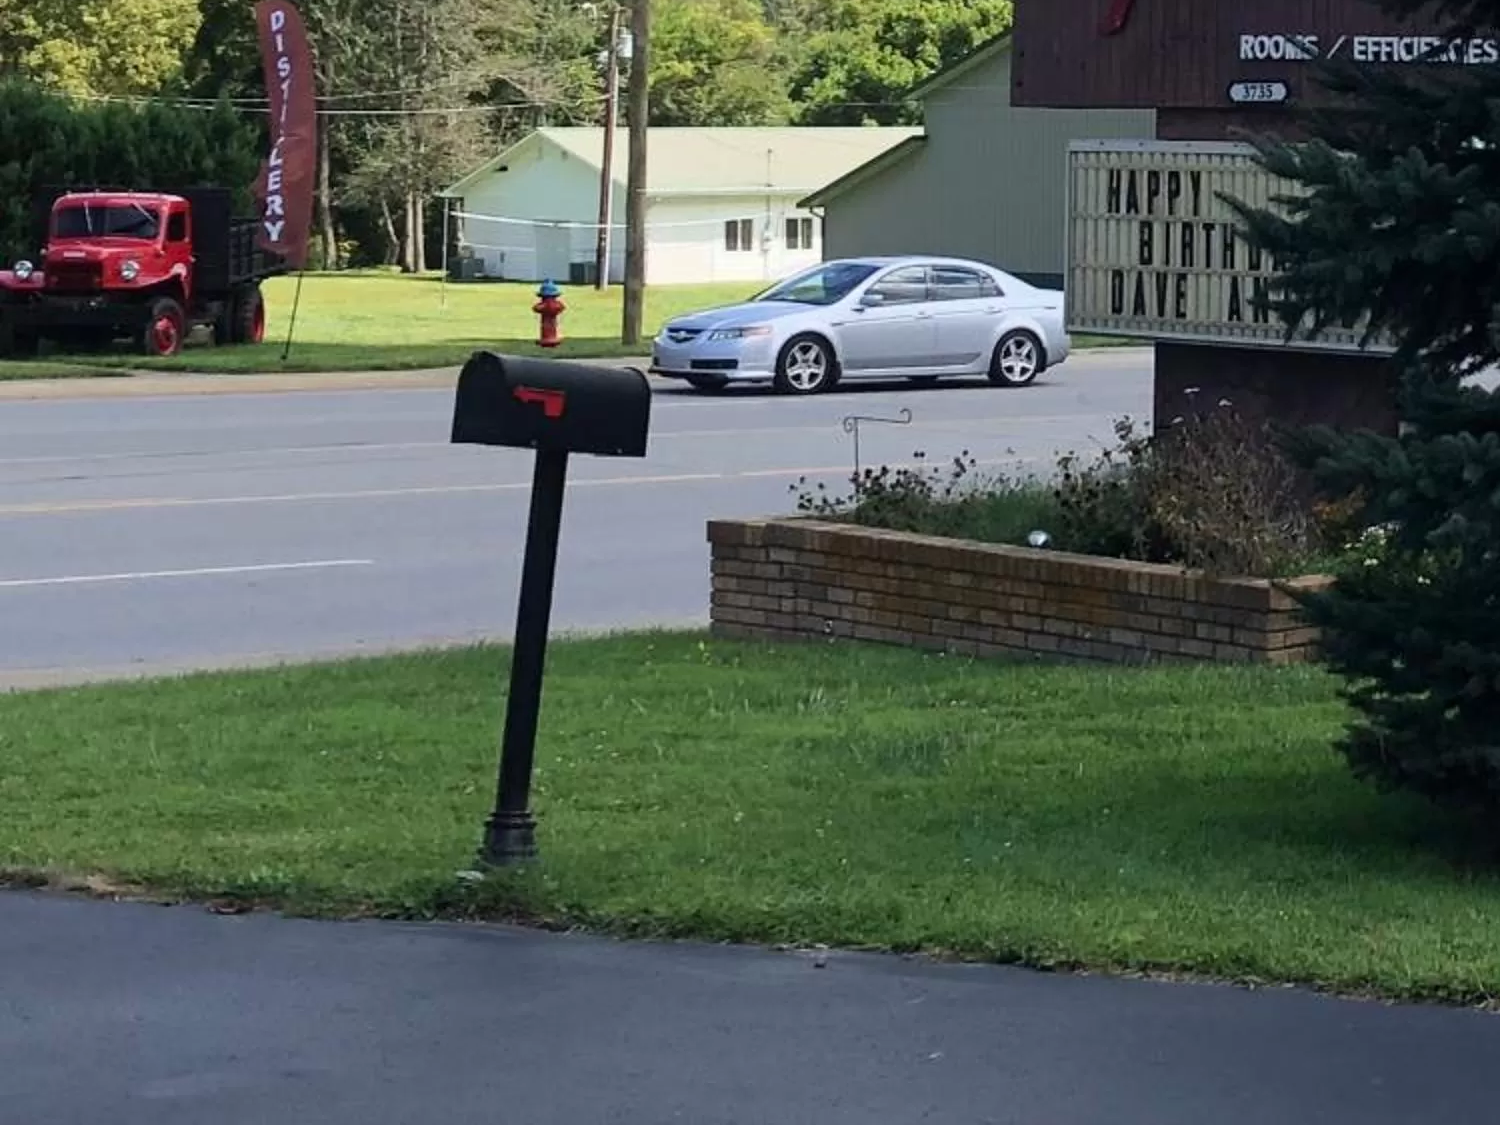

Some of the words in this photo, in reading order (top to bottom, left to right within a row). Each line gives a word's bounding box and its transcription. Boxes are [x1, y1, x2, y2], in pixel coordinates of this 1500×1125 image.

[1353, 36, 1499, 64] EFFICIECIES
[1241, 84, 1273, 100] 3735
[1107, 169, 1201, 217] HAPPY
[1139, 221, 1282, 272] BIRTHD
[1111, 269, 1187, 319] DAVE
[1228, 276, 1289, 324] AN
